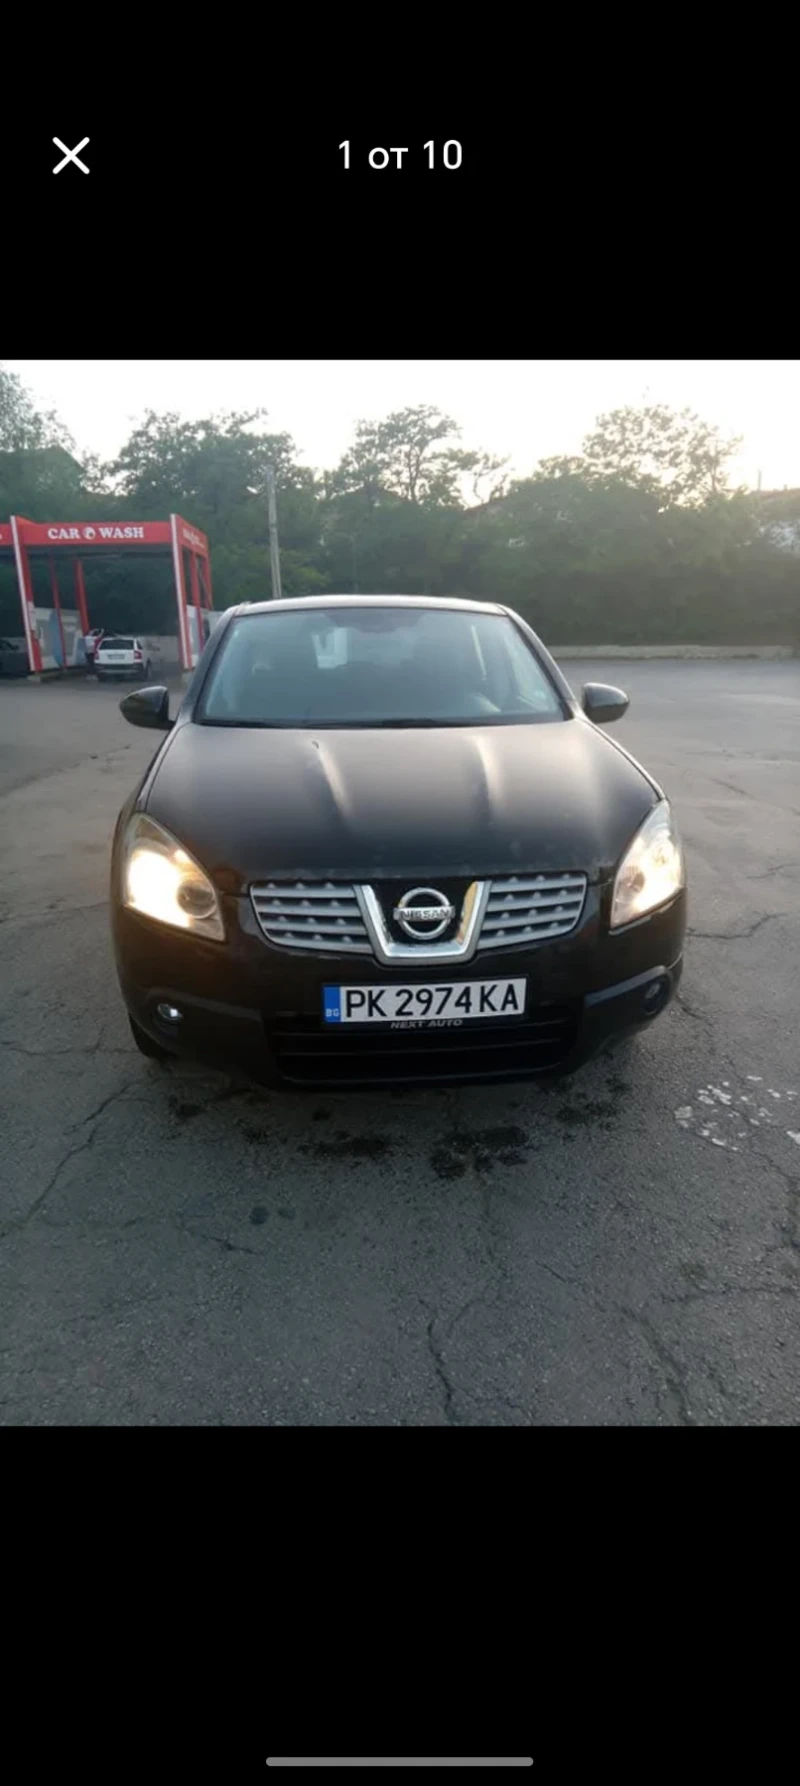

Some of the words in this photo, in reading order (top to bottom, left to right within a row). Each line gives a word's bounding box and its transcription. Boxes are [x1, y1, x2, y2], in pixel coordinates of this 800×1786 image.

[48, 528, 80, 539] CAR
[99, 527, 144, 538] WASH
[400, 908, 450, 920] NISSAN
[346, 989, 387, 1017] PK
[395, 986, 472, 1016] 2974
[480, 984, 518, 1012] KA
[326, 1009, 339, 1017] BG
[391, 1020, 425, 1029] NEXT
[427, 1019, 463, 1027] AUTO
